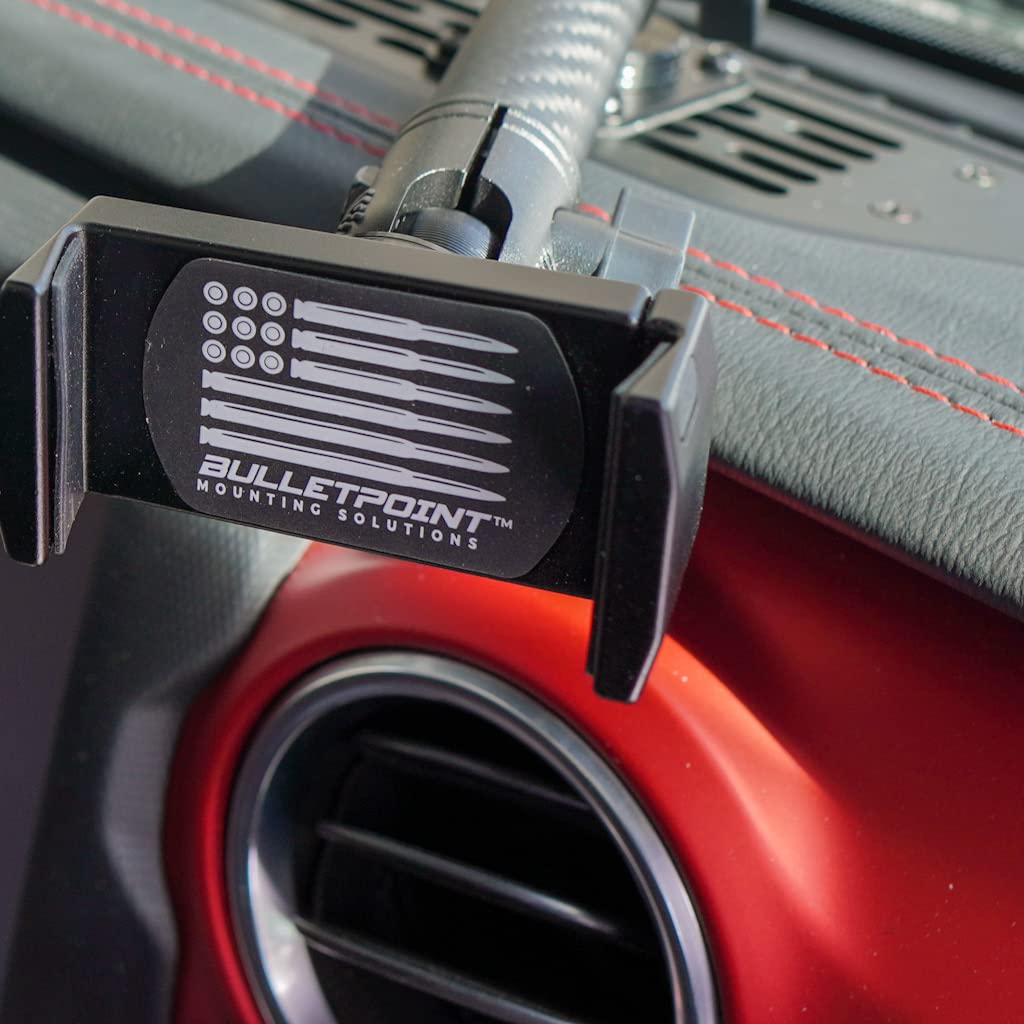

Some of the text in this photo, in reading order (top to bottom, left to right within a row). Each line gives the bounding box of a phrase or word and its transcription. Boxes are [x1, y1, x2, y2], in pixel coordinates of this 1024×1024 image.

[197, 478, 478, 550] MOUNTING SOLUTIONS
[198, 454, 492, 533] BULLETPOINT
